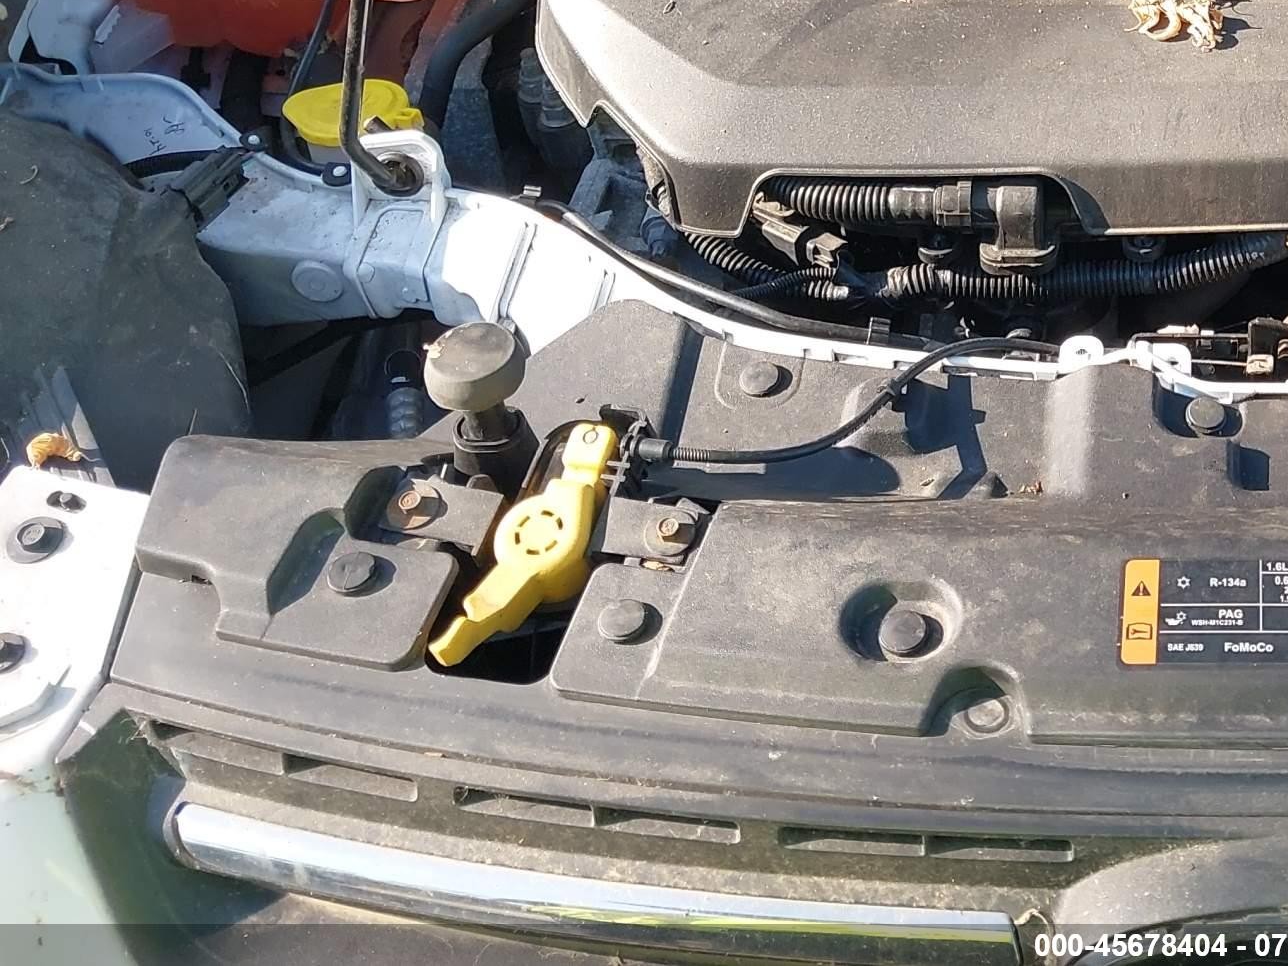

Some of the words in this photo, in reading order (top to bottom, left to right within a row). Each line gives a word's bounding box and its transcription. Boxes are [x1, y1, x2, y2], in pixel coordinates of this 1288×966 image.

[1266, 562, 1288, 571] 1.6L
[1209, 577, 1247, 587] R-134a
[1218, 609, 1243, 619] PAG
[1167, 643, 1184, 651] SAE
[1224, 642, 1274, 652] FoMoCo
